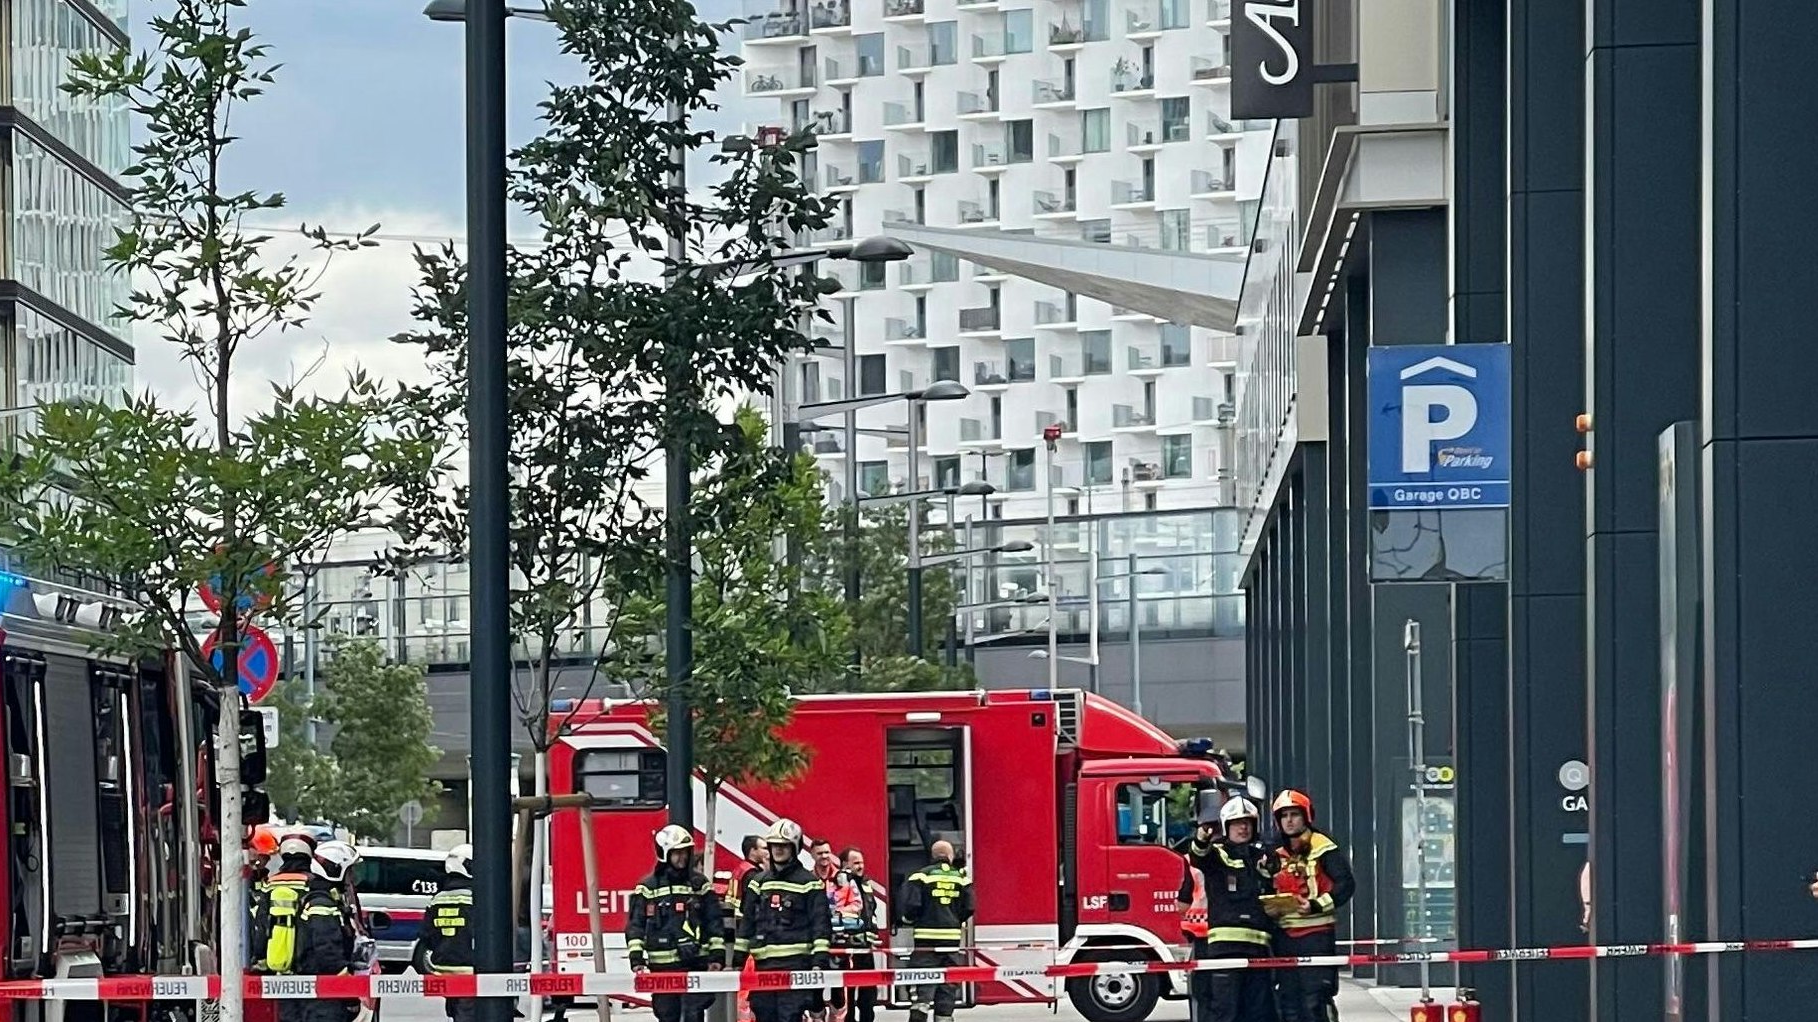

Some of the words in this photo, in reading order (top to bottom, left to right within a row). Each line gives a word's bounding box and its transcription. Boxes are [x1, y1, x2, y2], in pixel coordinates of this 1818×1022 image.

[1443, 454, 1493, 469] Parking
[1394, 488, 1444, 503] Garage
[1083, 896, 1108, 910] LSF
[564, 935, 588, 947] 100
